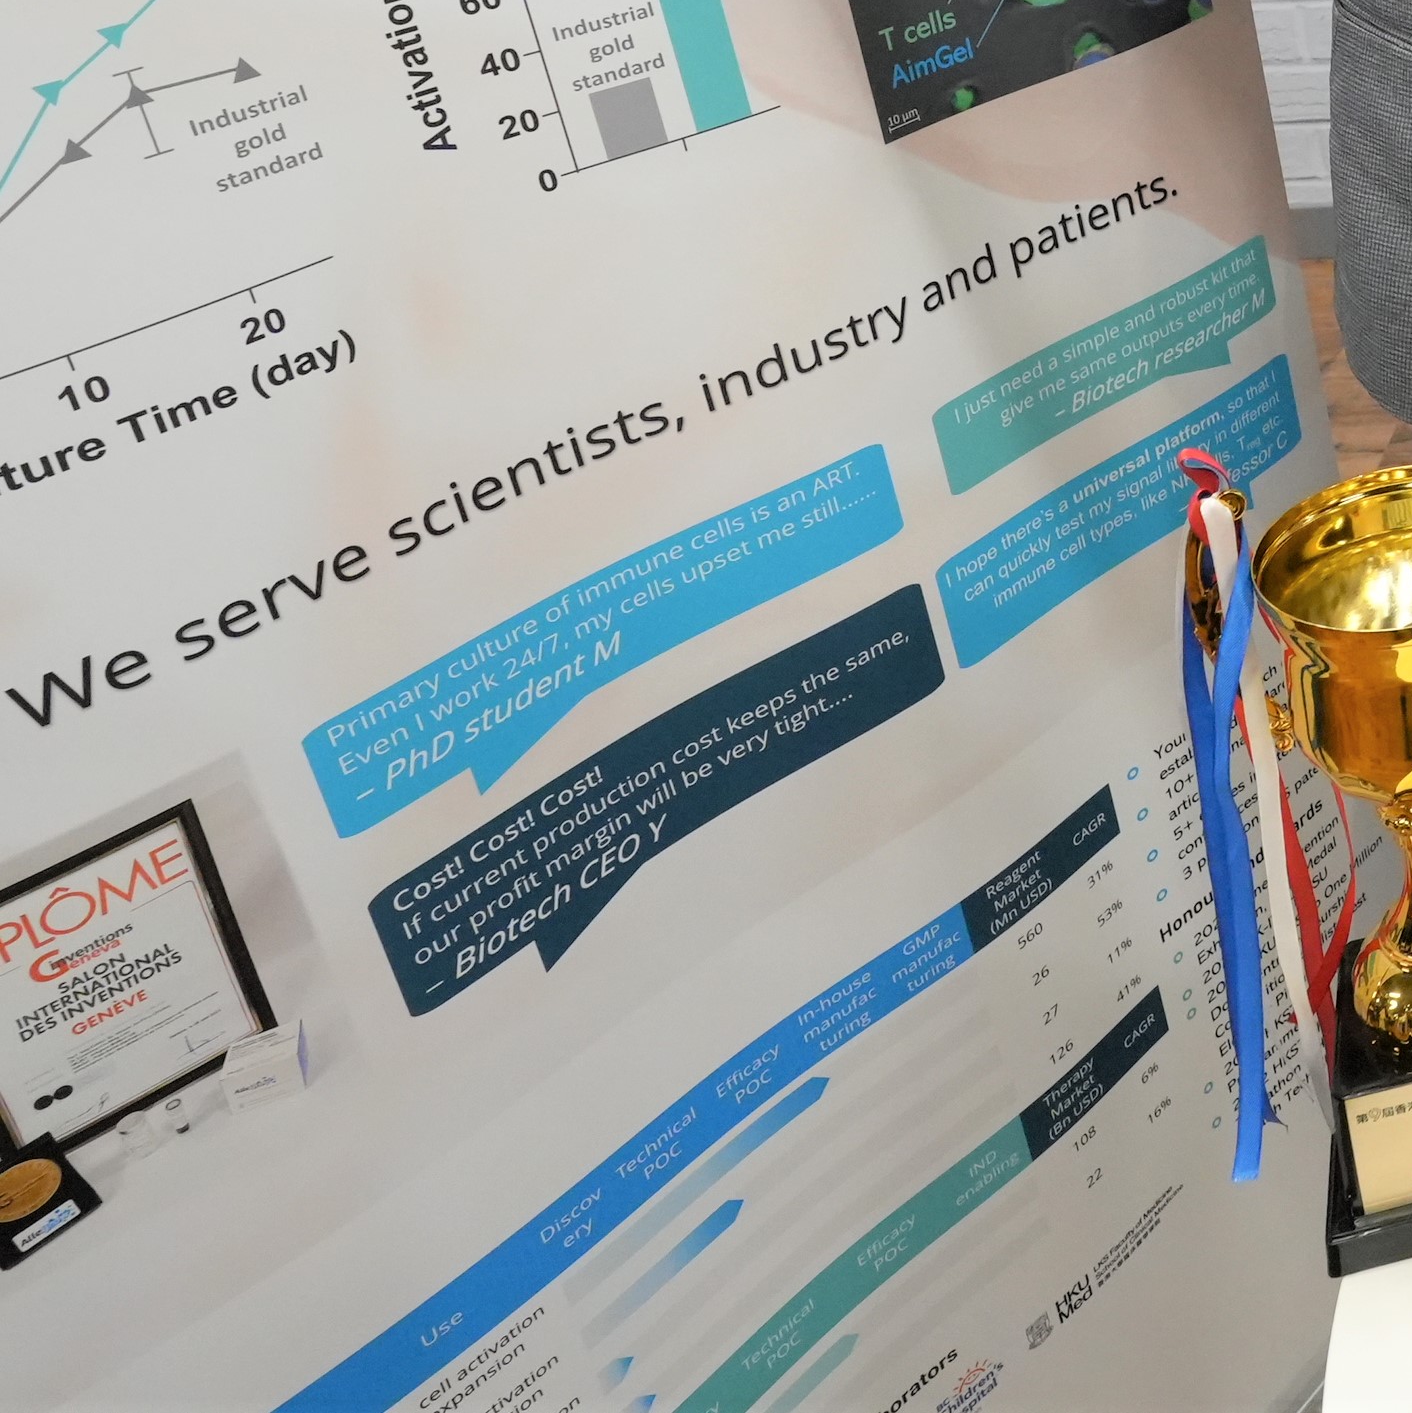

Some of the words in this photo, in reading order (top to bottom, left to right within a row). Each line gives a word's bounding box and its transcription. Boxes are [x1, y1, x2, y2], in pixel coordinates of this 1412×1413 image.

[877, 26, 894, 51] T
[905, 10, 956, 44] cells
[480, 48, 521, 76] 40
[893, 38, 973, 88] AimGel
[189, 85, 307, 136] Industrial
[498, 109, 539, 139] 20
[235, 123, 286, 158] gold
[216, 142, 323, 192] standard
[538, 169, 558, 191] 0
[57, 375, 111, 411] 10
[239, 308, 287, 345] 20
[116, 384, 239, 444] Time
[250, 329, 358, 400] (day)
[5, 651, 151, 727] We
[175, 545, 370, 661] serve
[389, 402, 684, 556] scientists,
[699, 296, 906, 412] industry
[923, 243, 997, 312] and
[1010, 177, 1177, 278] patients.
[328, 673, 438, 747] Primary
[448, 620, 537, 678] culture
[546, 594, 569, 622] of
[577, 546, 683, 606] immune
[691, 517, 744, 549] cells
[752, 506, 770, 523] is
[778, 491, 805, 511] an
[814, 462, 859, 506] ART.
[387, 731, 455, 790] PhD
[465, 654, 585, 743] student
[595, 631, 620, 666] M
[394, 856, 464, 911] Cost!
[470, 810, 535, 862] Cost!
[541, 766, 603, 815] Cost!
[1072, 812, 1107, 846] CAGR
[0, 839, 189, 963] PLÔME
[1017, 922, 1044, 950] 560
[1087, 860, 1114, 890] 31%
[902, 924, 941, 957] GMP
[71, 989, 148, 1036] GENÈVE
[1055, 1274, 1090, 1313] HKU
[1058, 1285, 1093, 1324] Med
